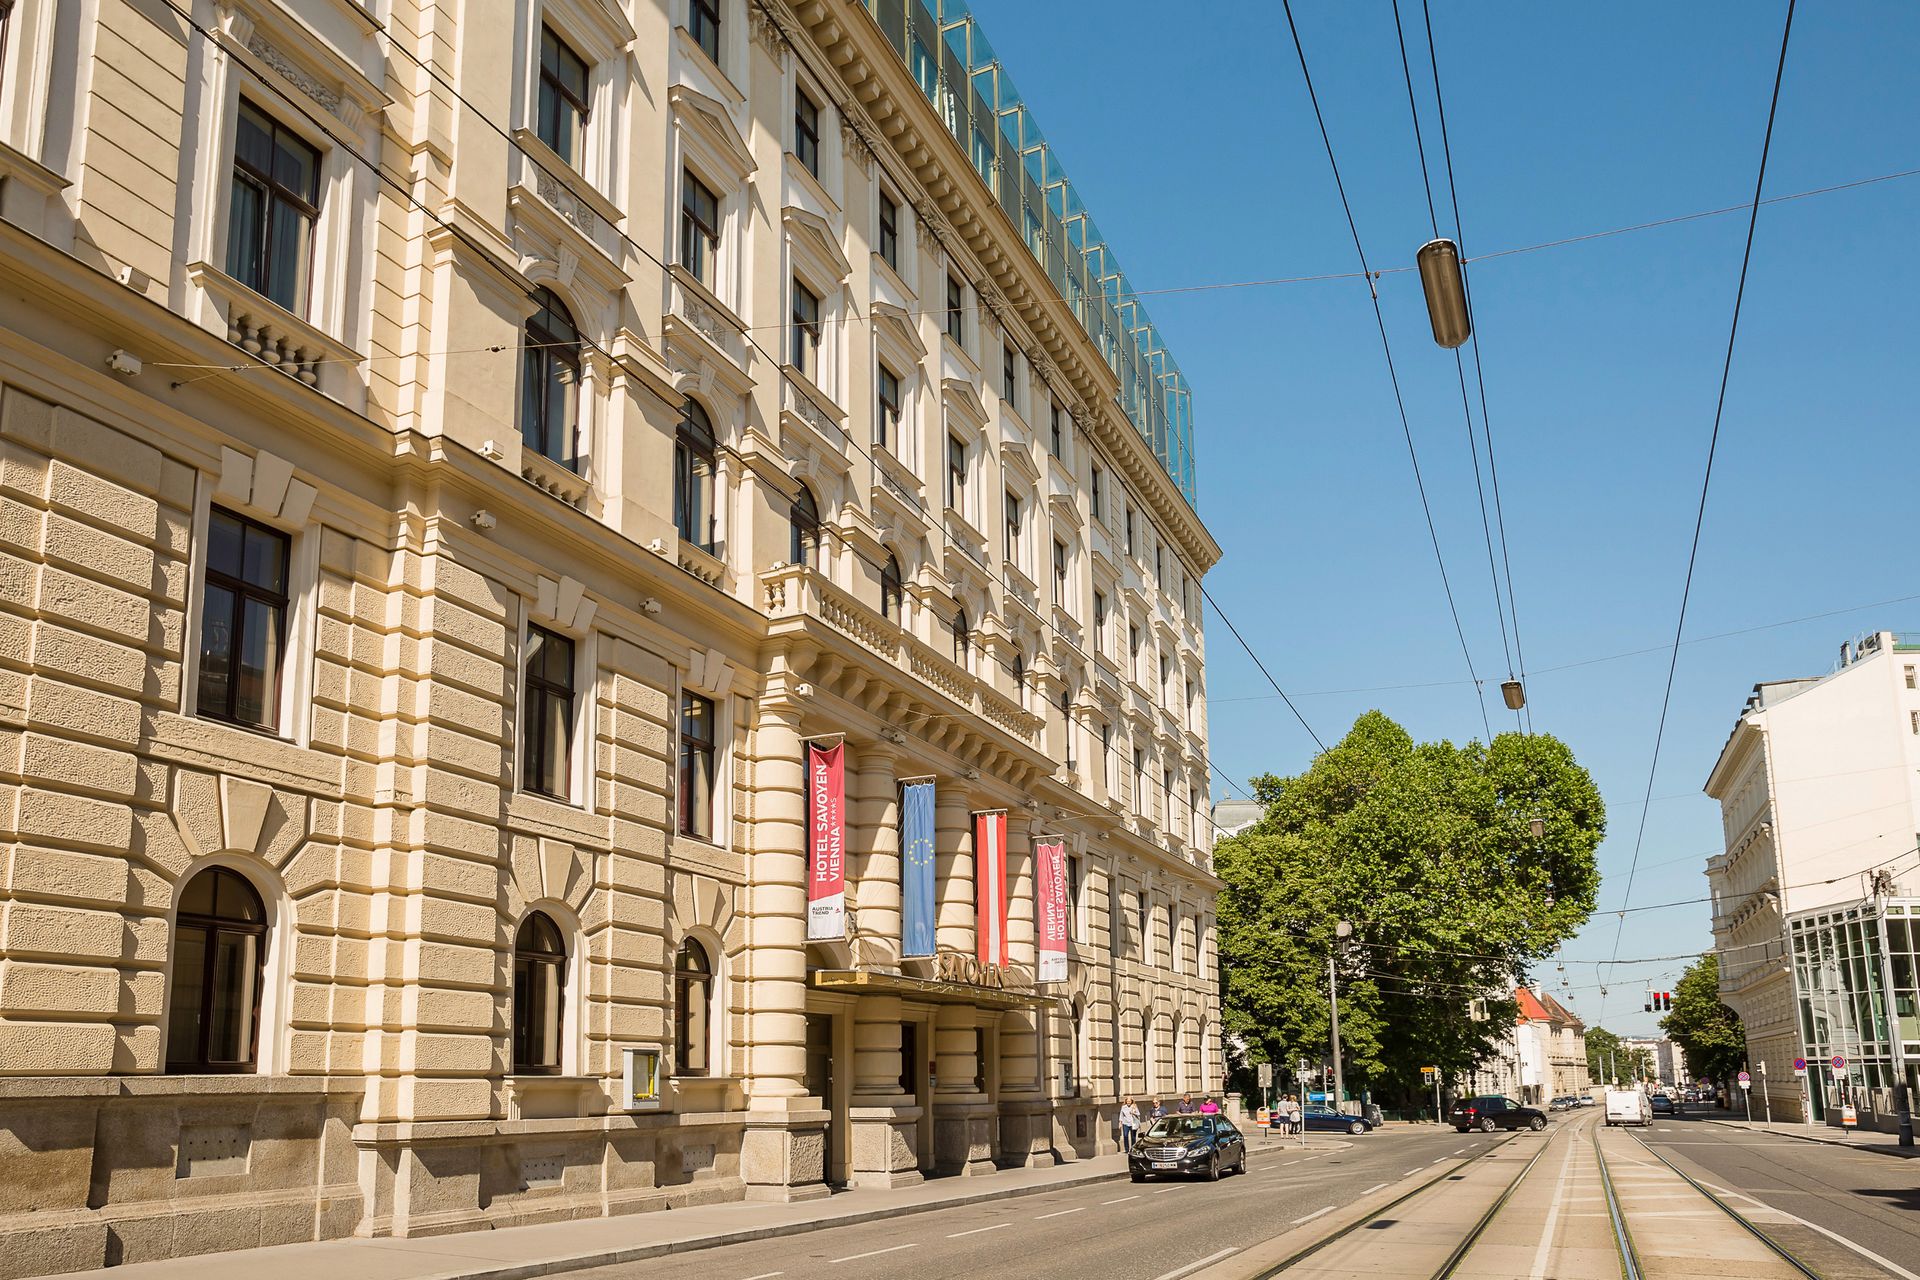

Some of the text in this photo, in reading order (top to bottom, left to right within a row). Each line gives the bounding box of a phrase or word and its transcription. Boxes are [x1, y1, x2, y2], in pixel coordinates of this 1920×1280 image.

[816, 764, 828, 882] HOTEL SAVOYEN
[829, 826, 840, 882] VIENNA
